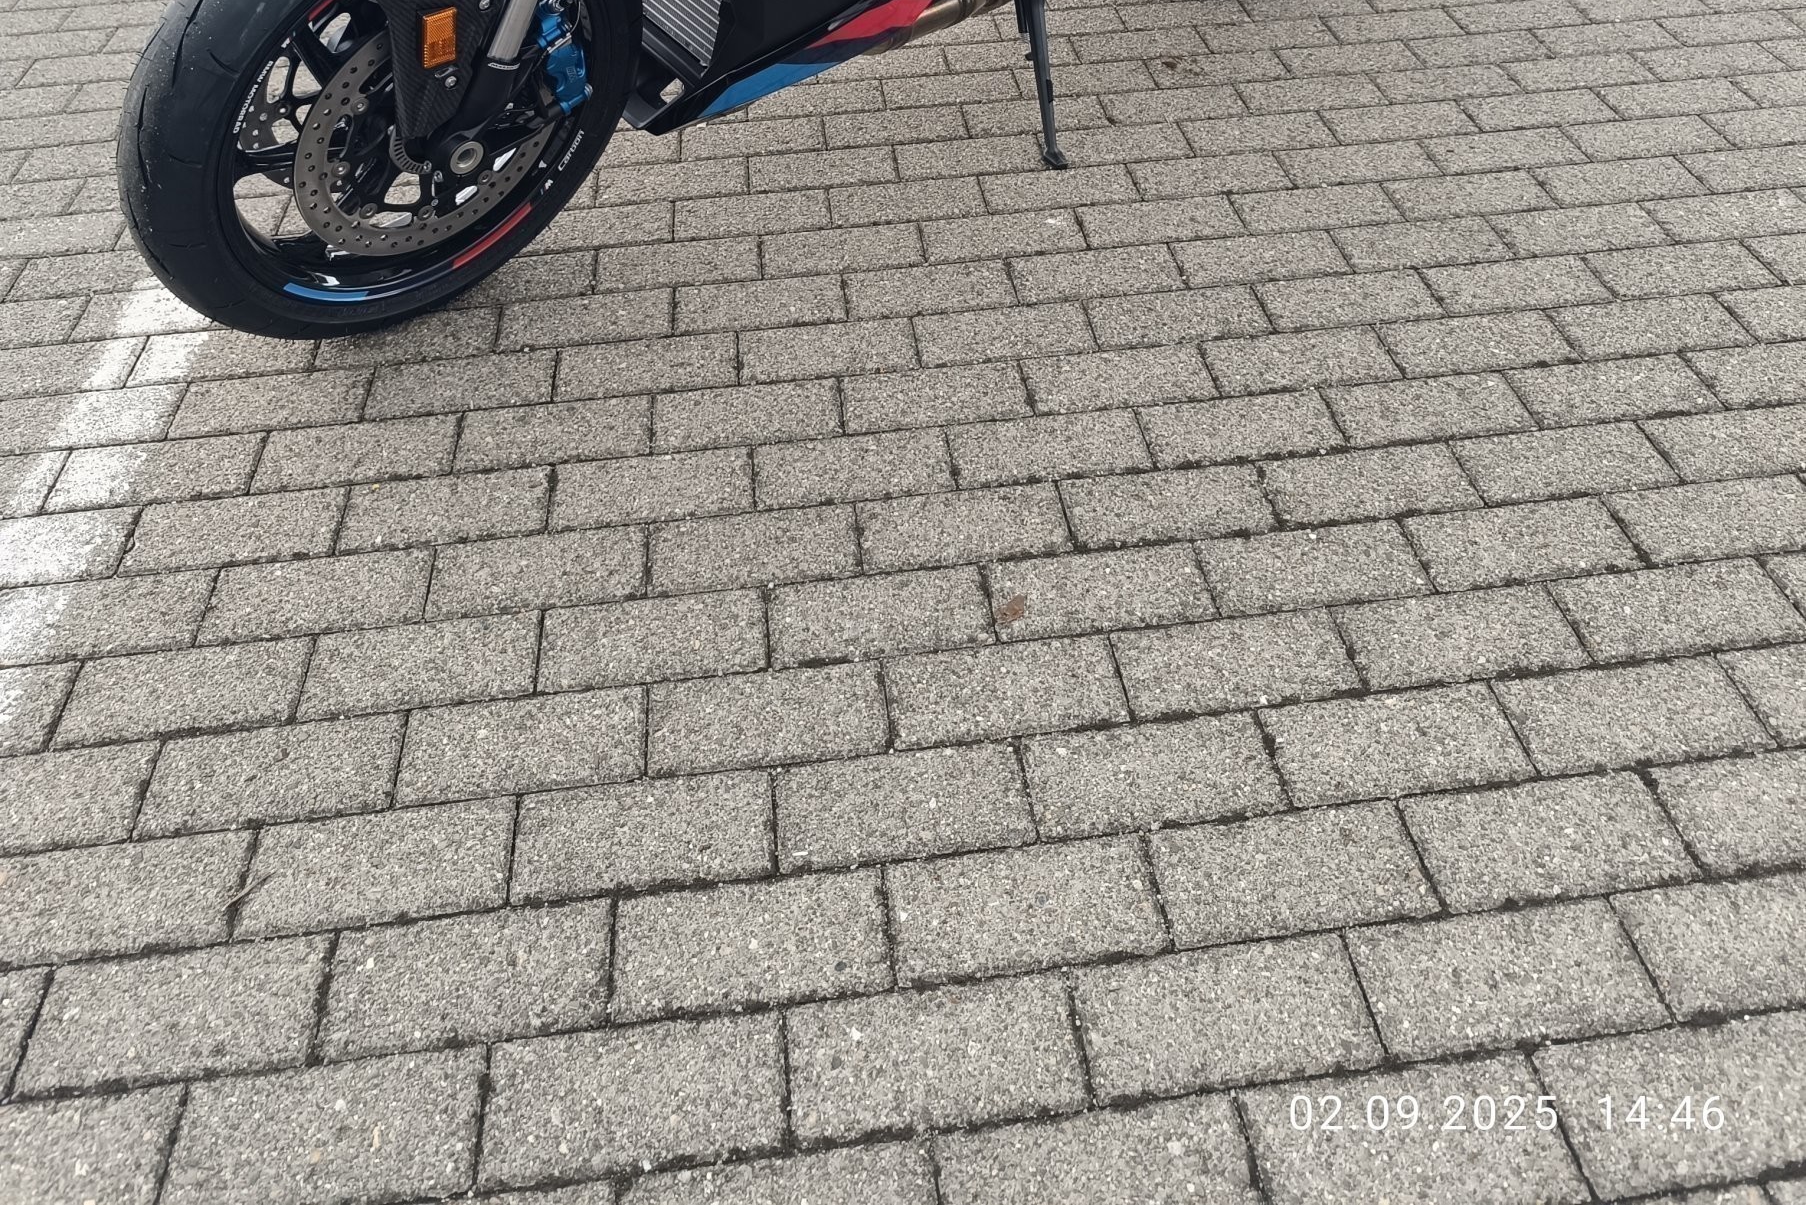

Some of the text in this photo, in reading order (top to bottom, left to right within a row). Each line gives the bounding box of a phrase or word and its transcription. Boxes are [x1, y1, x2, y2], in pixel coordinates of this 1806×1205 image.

[257, 60, 274, 83] BMW
[233, 84, 259, 134] MOTORRAD
[557, 129, 585, 172] Carbon
